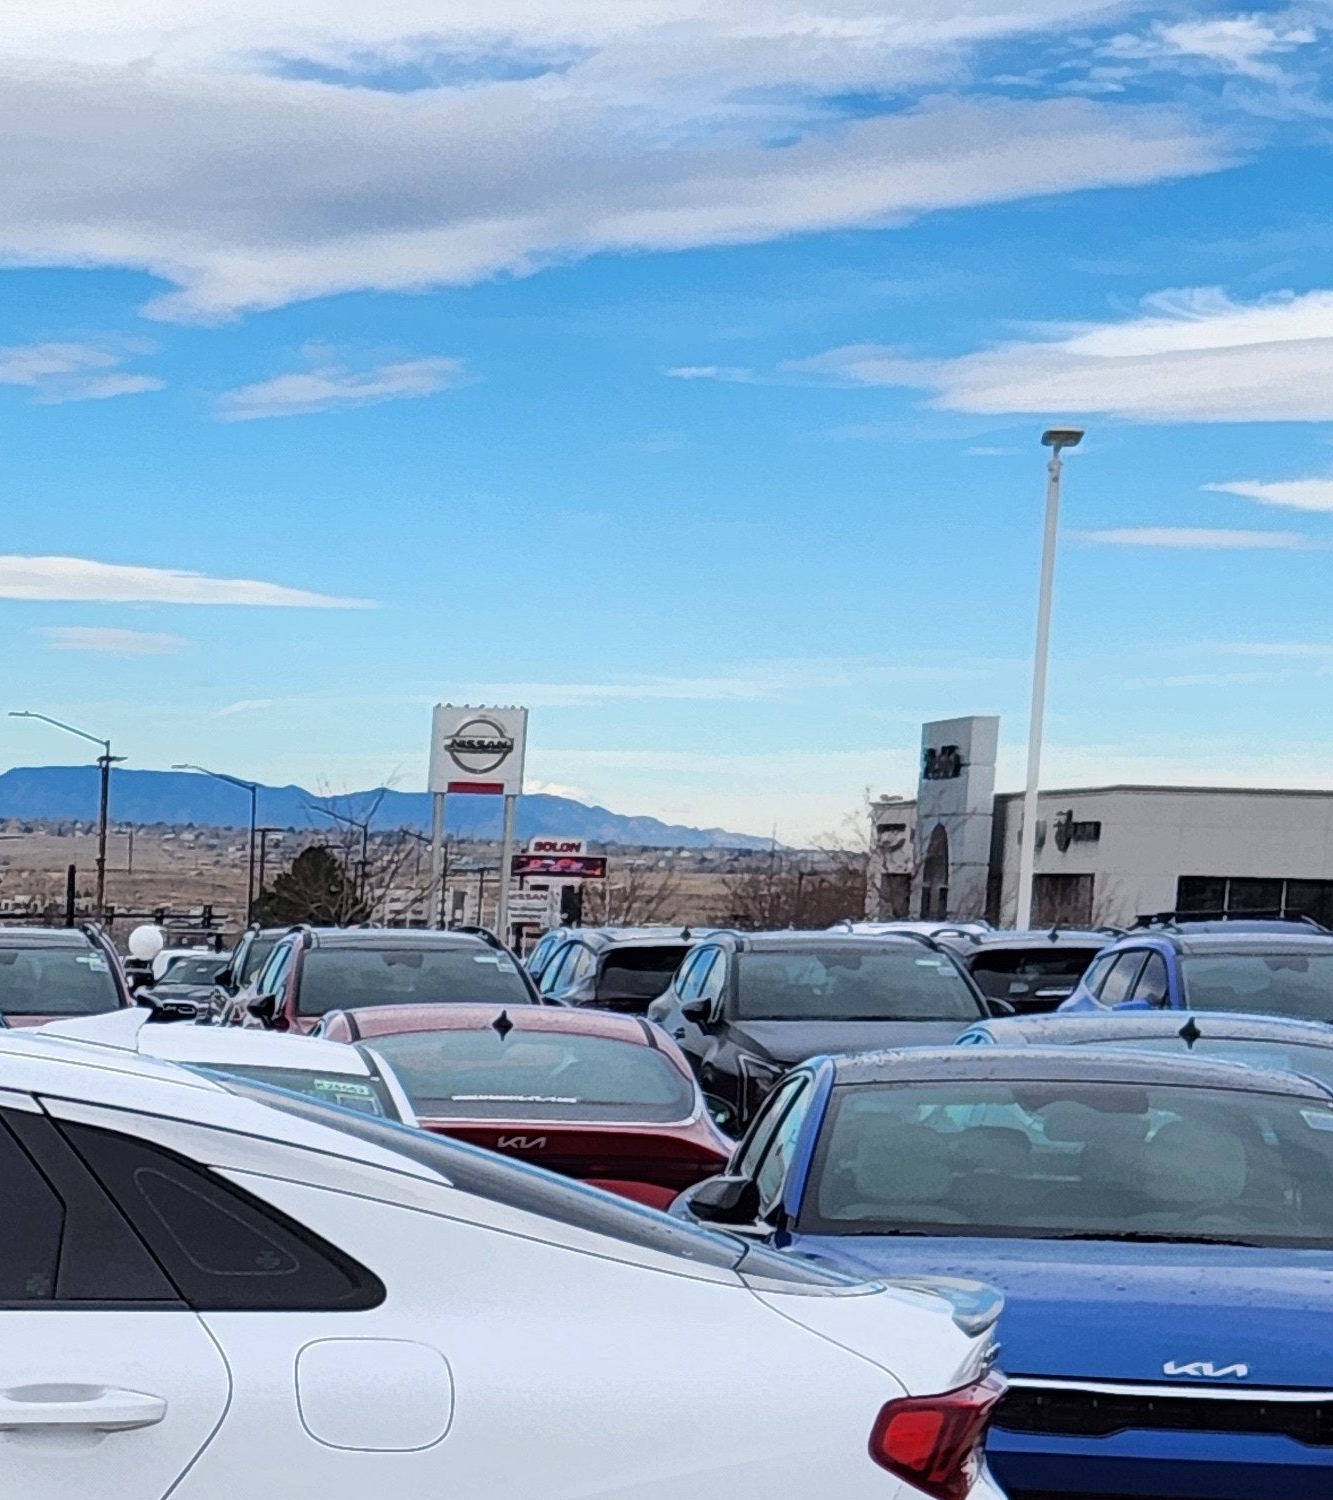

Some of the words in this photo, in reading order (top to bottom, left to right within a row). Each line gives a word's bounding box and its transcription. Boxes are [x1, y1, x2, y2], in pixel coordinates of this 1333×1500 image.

[452, 739, 509, 749] NISSAN
[534, 842, 581, 853] SOLON
[1163, 1361, 1248, 1378] KIA
